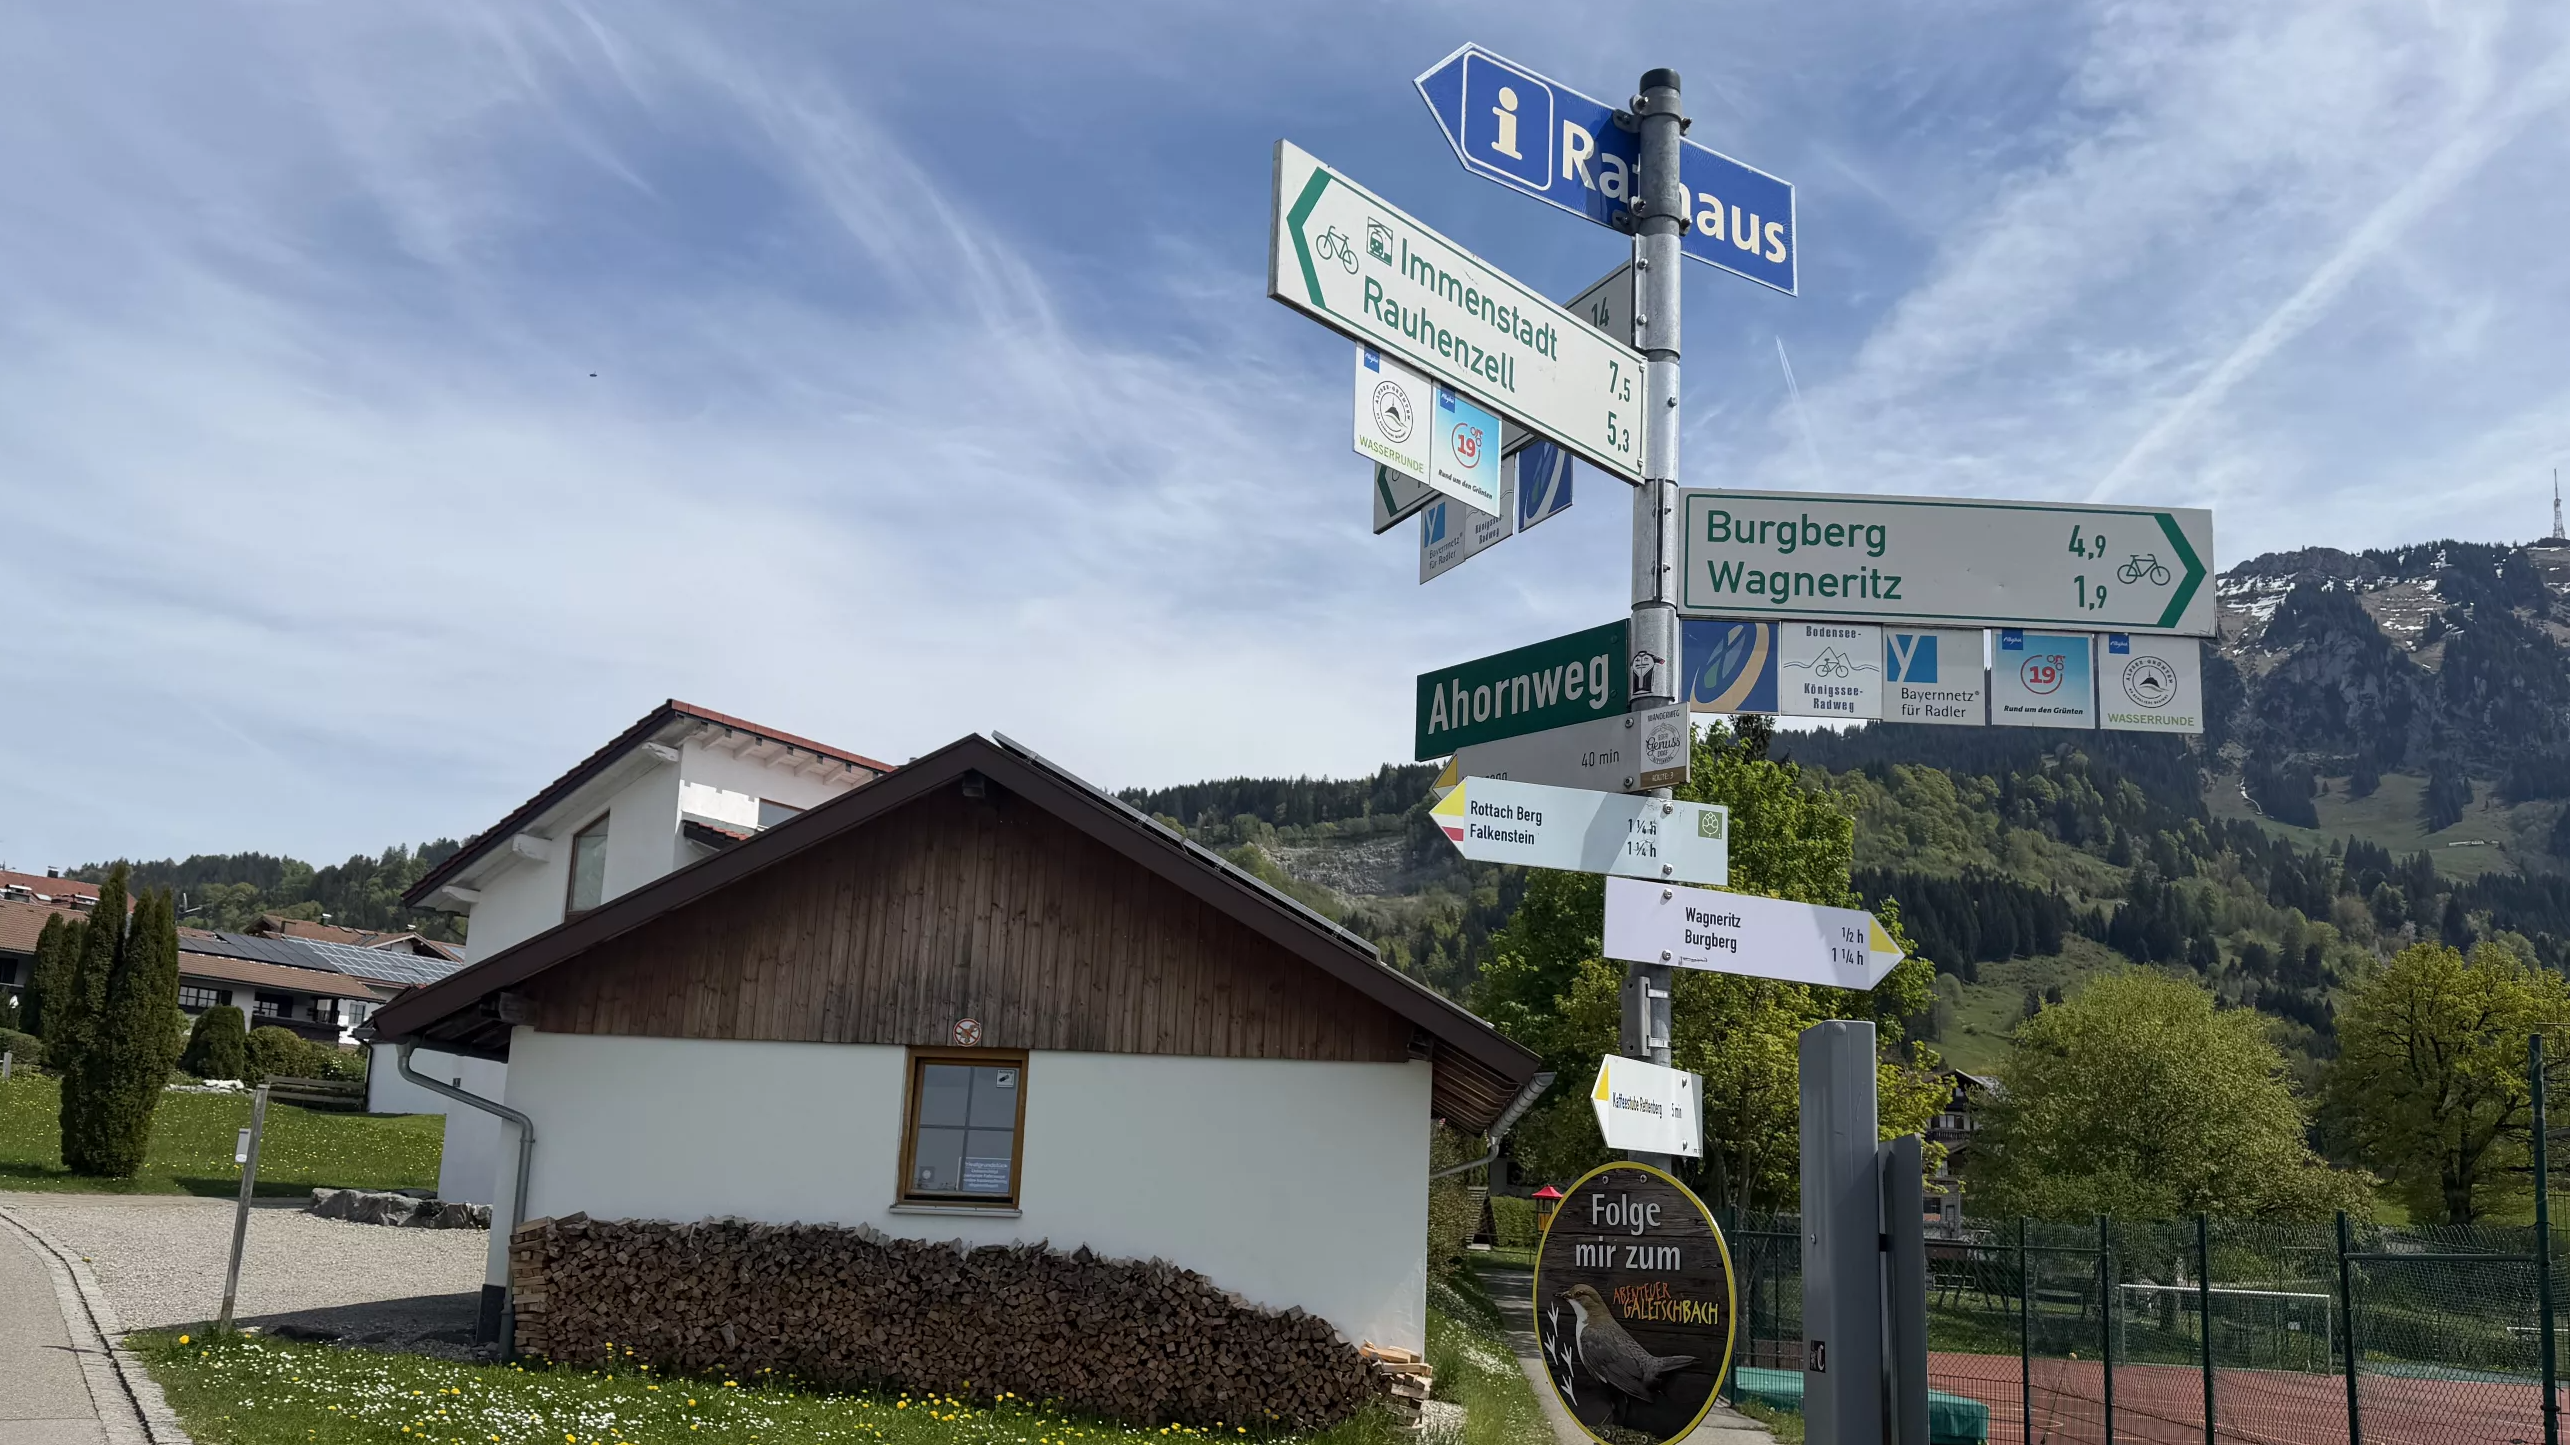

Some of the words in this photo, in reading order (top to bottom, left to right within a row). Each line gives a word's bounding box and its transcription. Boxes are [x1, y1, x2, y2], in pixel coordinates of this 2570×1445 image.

[1562, 119, 1787, 264] Raaus
[1401, 238, 1558, 361] Immenstadt
[1609, 360, 1631, 403] 7,5
[1363, 275, 1515, 394] Rauhenzell
[1607, 411, 1629, 454] 5,3
[1359, 434, 1425, 475] WASSERRUNDE
[1457, 433, 1476, 458] 19
[1438, 468, 1453, 481] Rund
[1453, 476, 1461, 486] um
[1462, 480, 1472, 490] den
[1472, 485, 1493, 500] Grünten
[1706, 510, 1887, 557] Burgberg
[2068, 524, 2107, 562] 4,9
[1707, 560, 1903, 604] Wagneritz
[2073, 575, 2107, 611] 1,9
[1805, 625, 1862, 639] Bodensee-
[1804, 682, 1864, 697] Königssee-
[2029, 665, 2056, 684] 19
[1428, 652, 1609, 735] Ahornweg
[1813, 697, 1855, 713] Radweg
[1647, 708, 1680, 722] WANDERWEG
[1901, 703, 1920, 716] für
[1925, 704, 1967, 718] Radler
[2003, 705, 2024, 713] Rund
[2038, 706, 2052, 714] den
[2053, 707, 2084, 715] Grünten
[2107, 712, 2195, 727] WASSERRUNDE
[1581, 751, 1595, 768] 40
[1599, 750, 1620, 765] min
[1645, 737, 1681, 757] Genuss
[1470, 800, 1513, 820] Rottach
[1516, 805, 1543, 827] Berg
[1649, 820, 1657, 836] h
[1470, 823, 1535, 846] Falkenstein
[1649, 843, 1657, 858] h
[1685, 906, 1741, 928] Wagneritz
[1857, 928, 1864, 944] h
[1684, 928, 1737, 954] Burgberg
[1857, 950, 1864, 966] h
[1612, 1091, 1639, 1112] Kaffeestube
[1592, 1193, 1661, 1236] Folge
[1575, 1236, 1617, 1268] mir
[1625, 1243, 1681, 1271] zum
[1613, 1281, 1672, 1305] ABENTEUER
[1623, 1297, 1719, 1325] GALETSCHBACH
